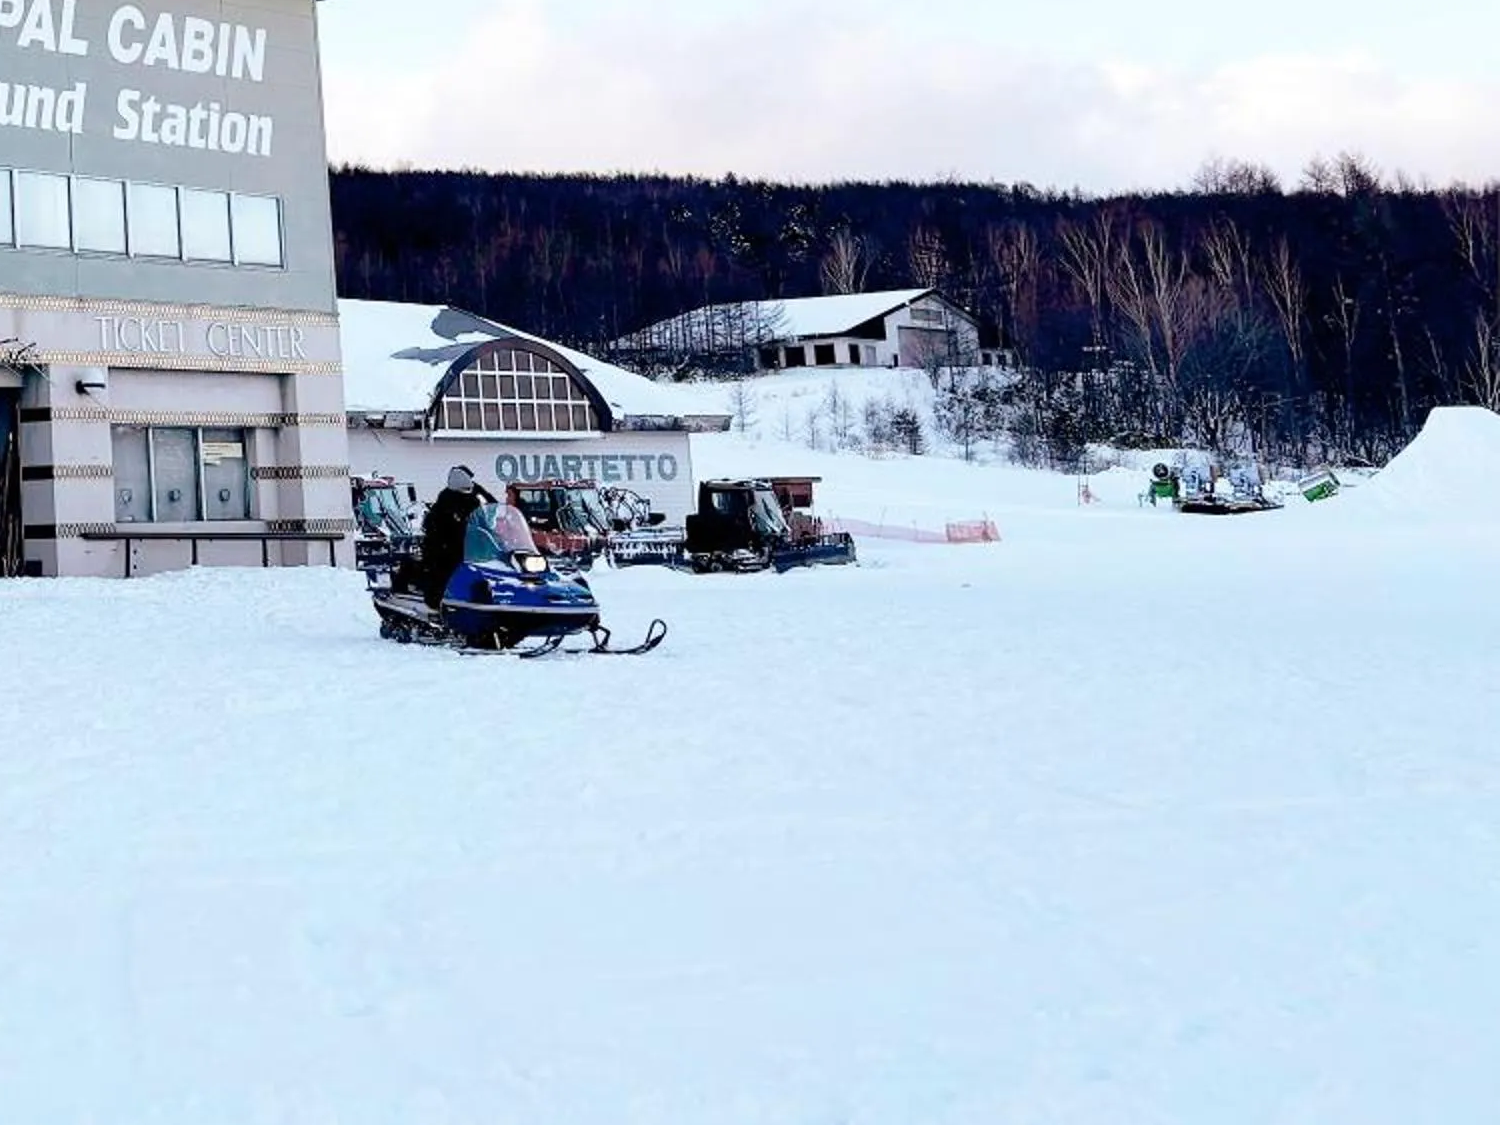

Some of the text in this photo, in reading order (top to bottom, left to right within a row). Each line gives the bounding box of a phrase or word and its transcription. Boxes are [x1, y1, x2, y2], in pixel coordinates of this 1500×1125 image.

[108, 5, 266, 81] CABIN
[114, 89, 273, 156] Station
[95, 316, 307, 360] TICKET CENTER
[495, 453, 678, 482] QUARTETTO
